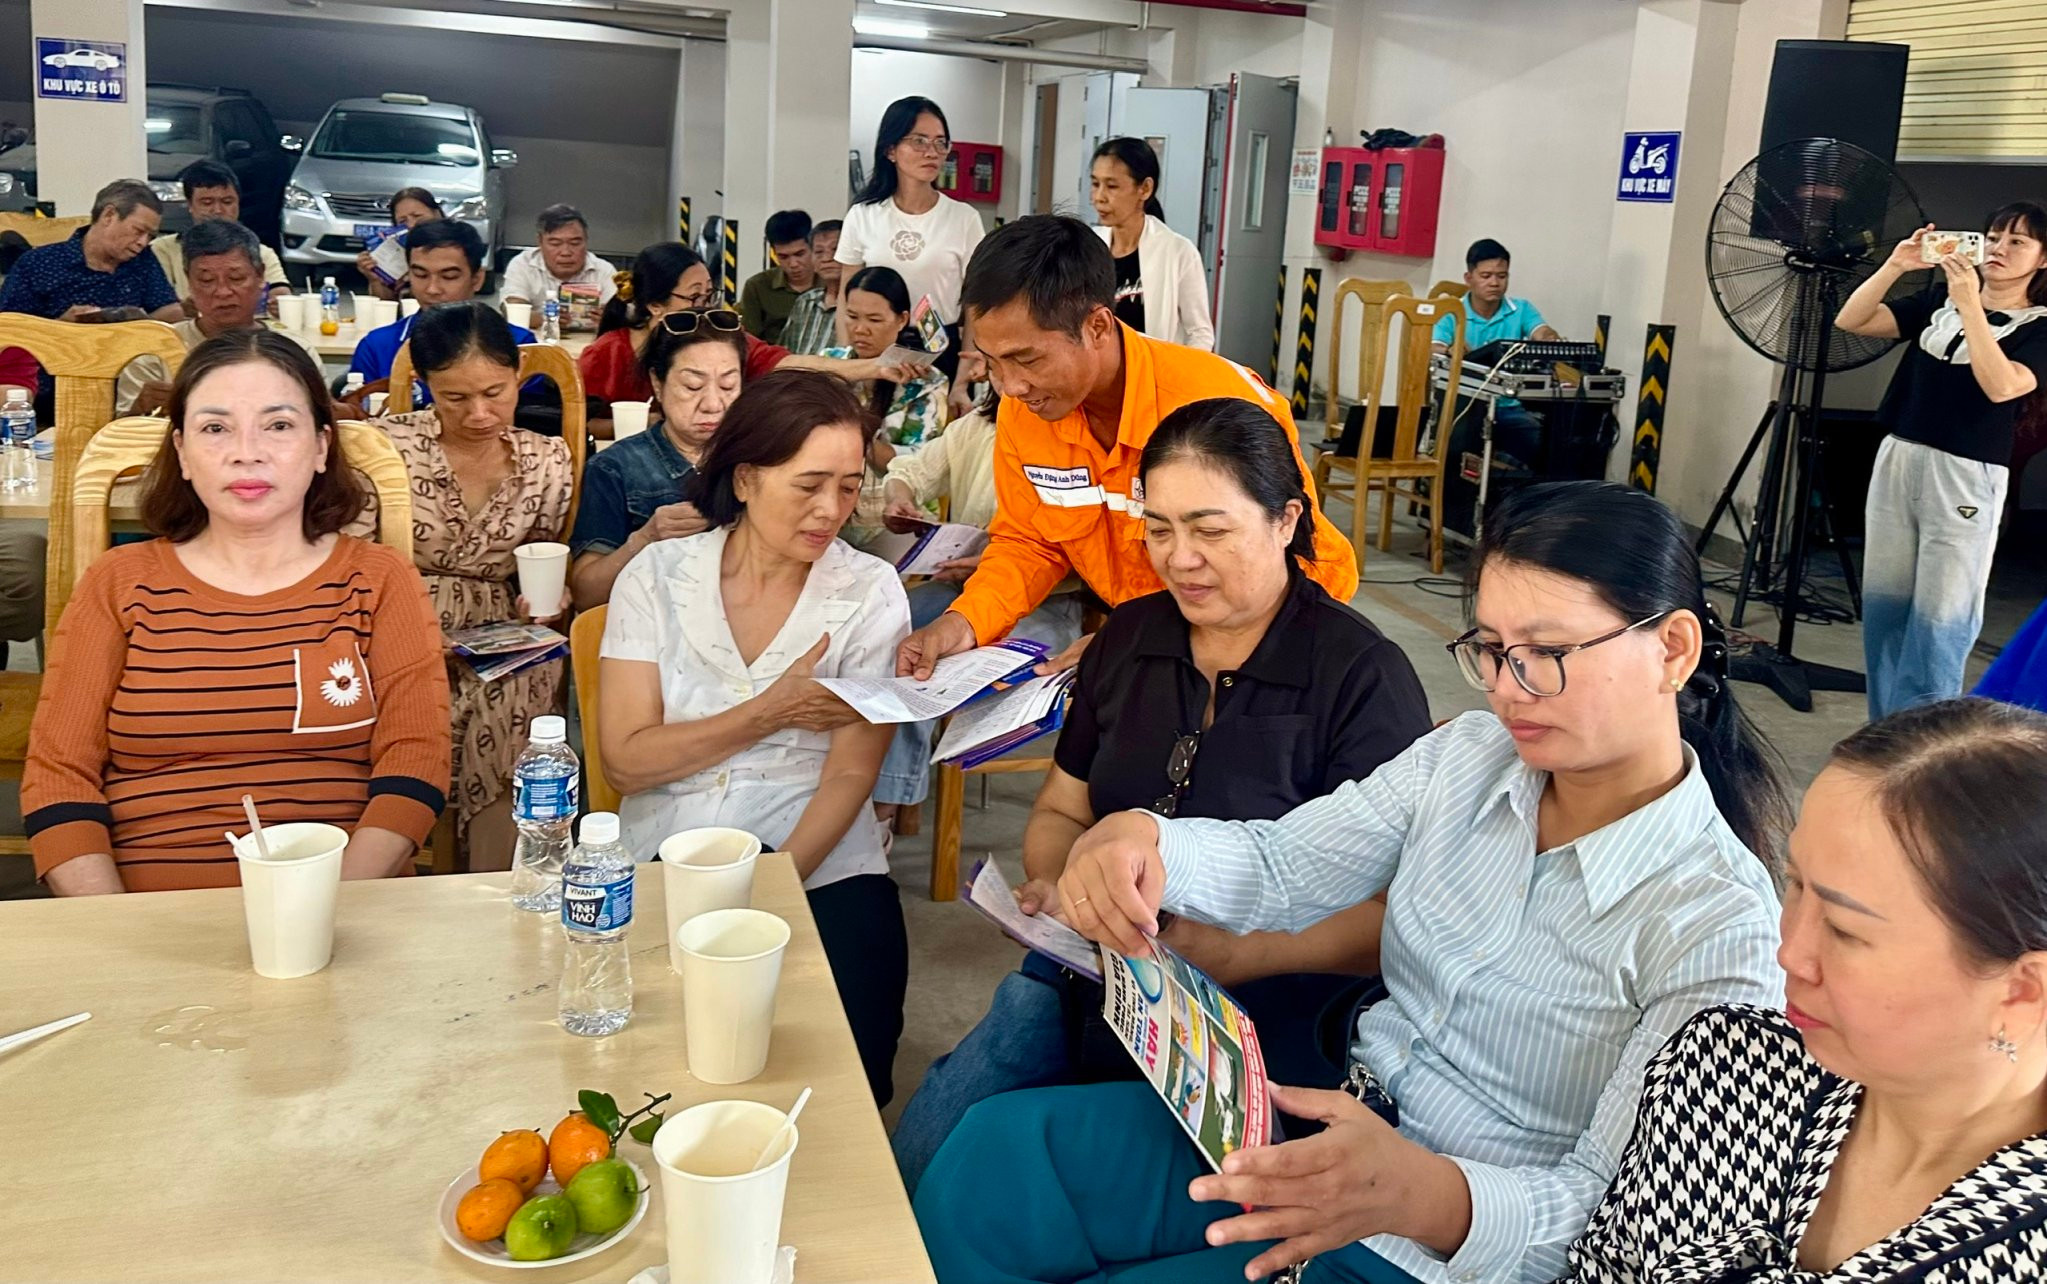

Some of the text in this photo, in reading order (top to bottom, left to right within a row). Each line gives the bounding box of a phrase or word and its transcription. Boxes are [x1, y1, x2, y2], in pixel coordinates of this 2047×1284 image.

[43, 78, 120, 95] KHU VỰC XE Ô TÔ
[1621, 176, 1671, 195] KHU VỰC XE MÁY
[570, 887, 597, 897] VIVANT
